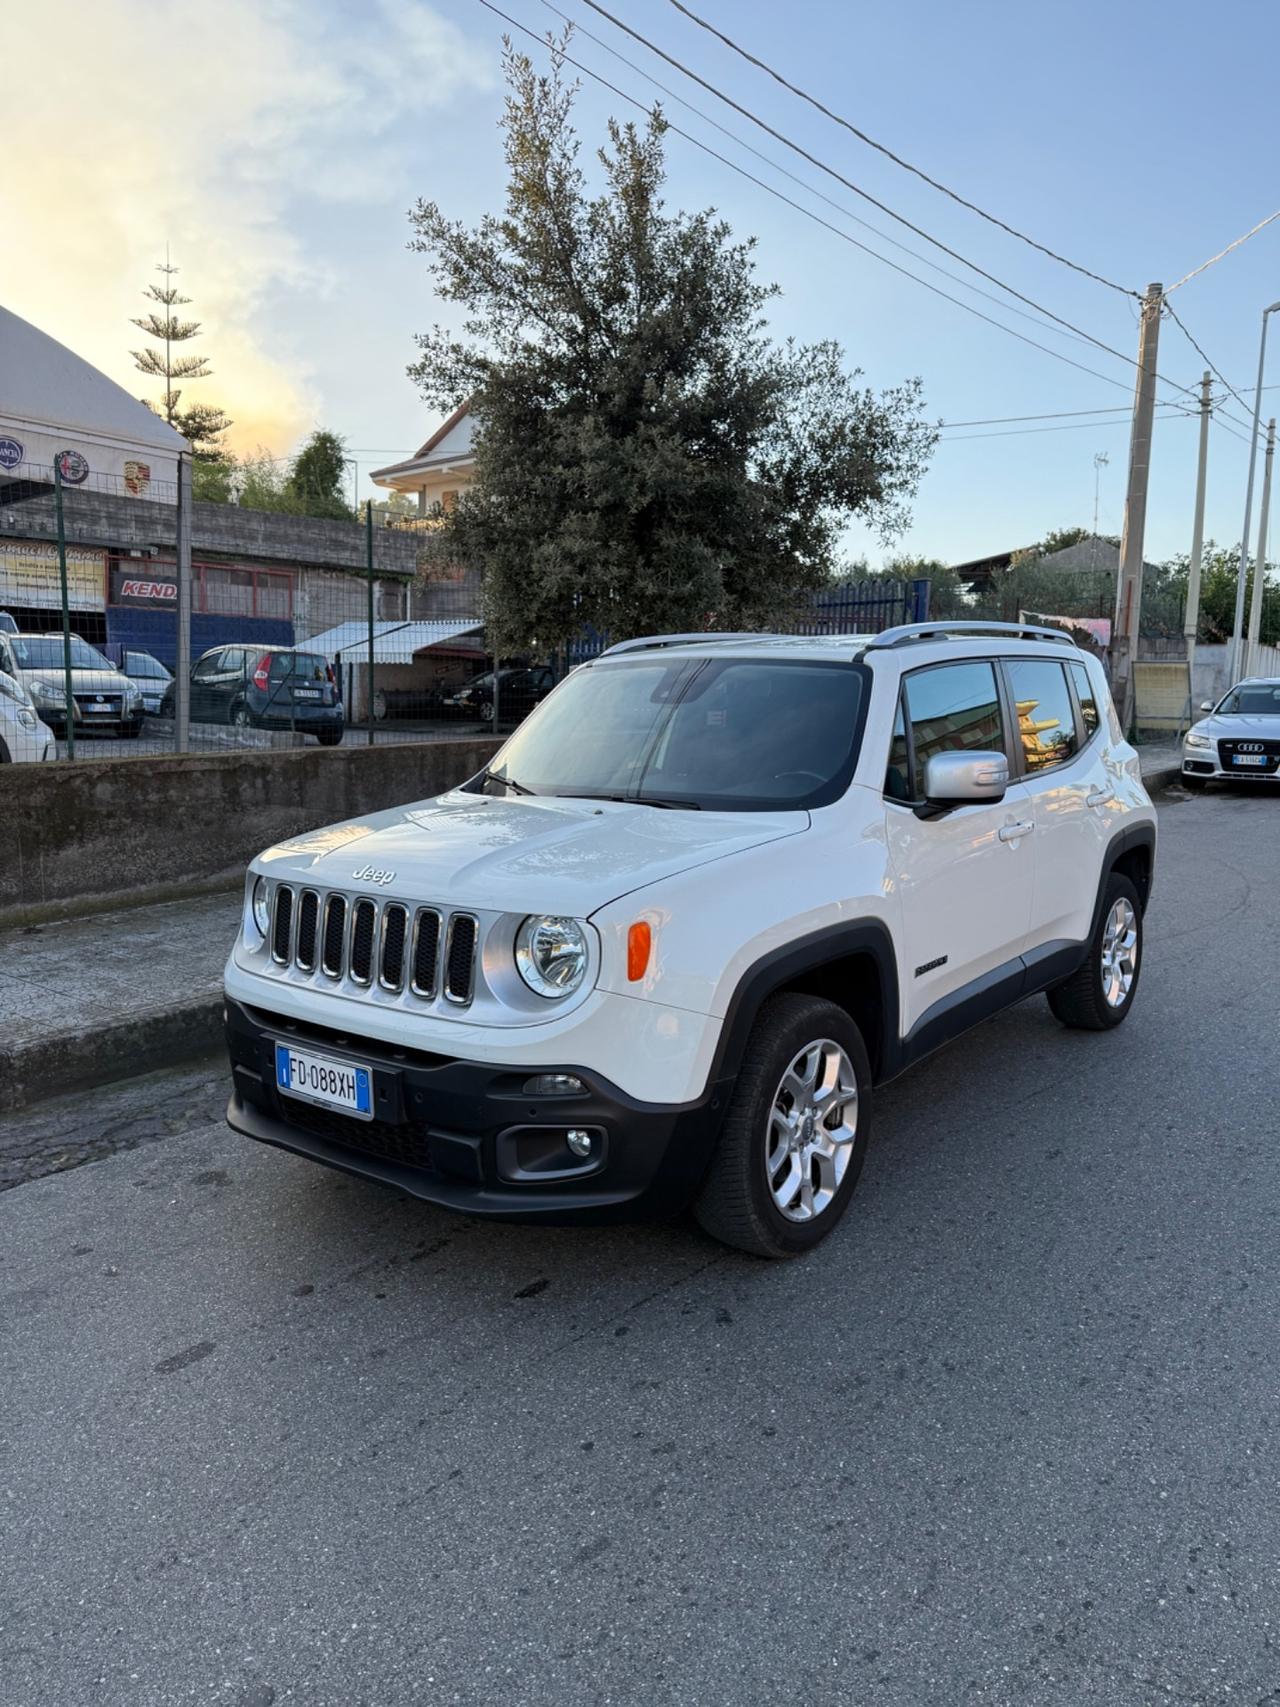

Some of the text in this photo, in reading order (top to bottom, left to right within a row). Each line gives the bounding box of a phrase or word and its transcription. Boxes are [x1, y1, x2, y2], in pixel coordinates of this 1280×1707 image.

[0, 448, 19, 458] ANCIA
[121, 580, 178, 600] KEND
[352, 865, 396, 886] Jeep
